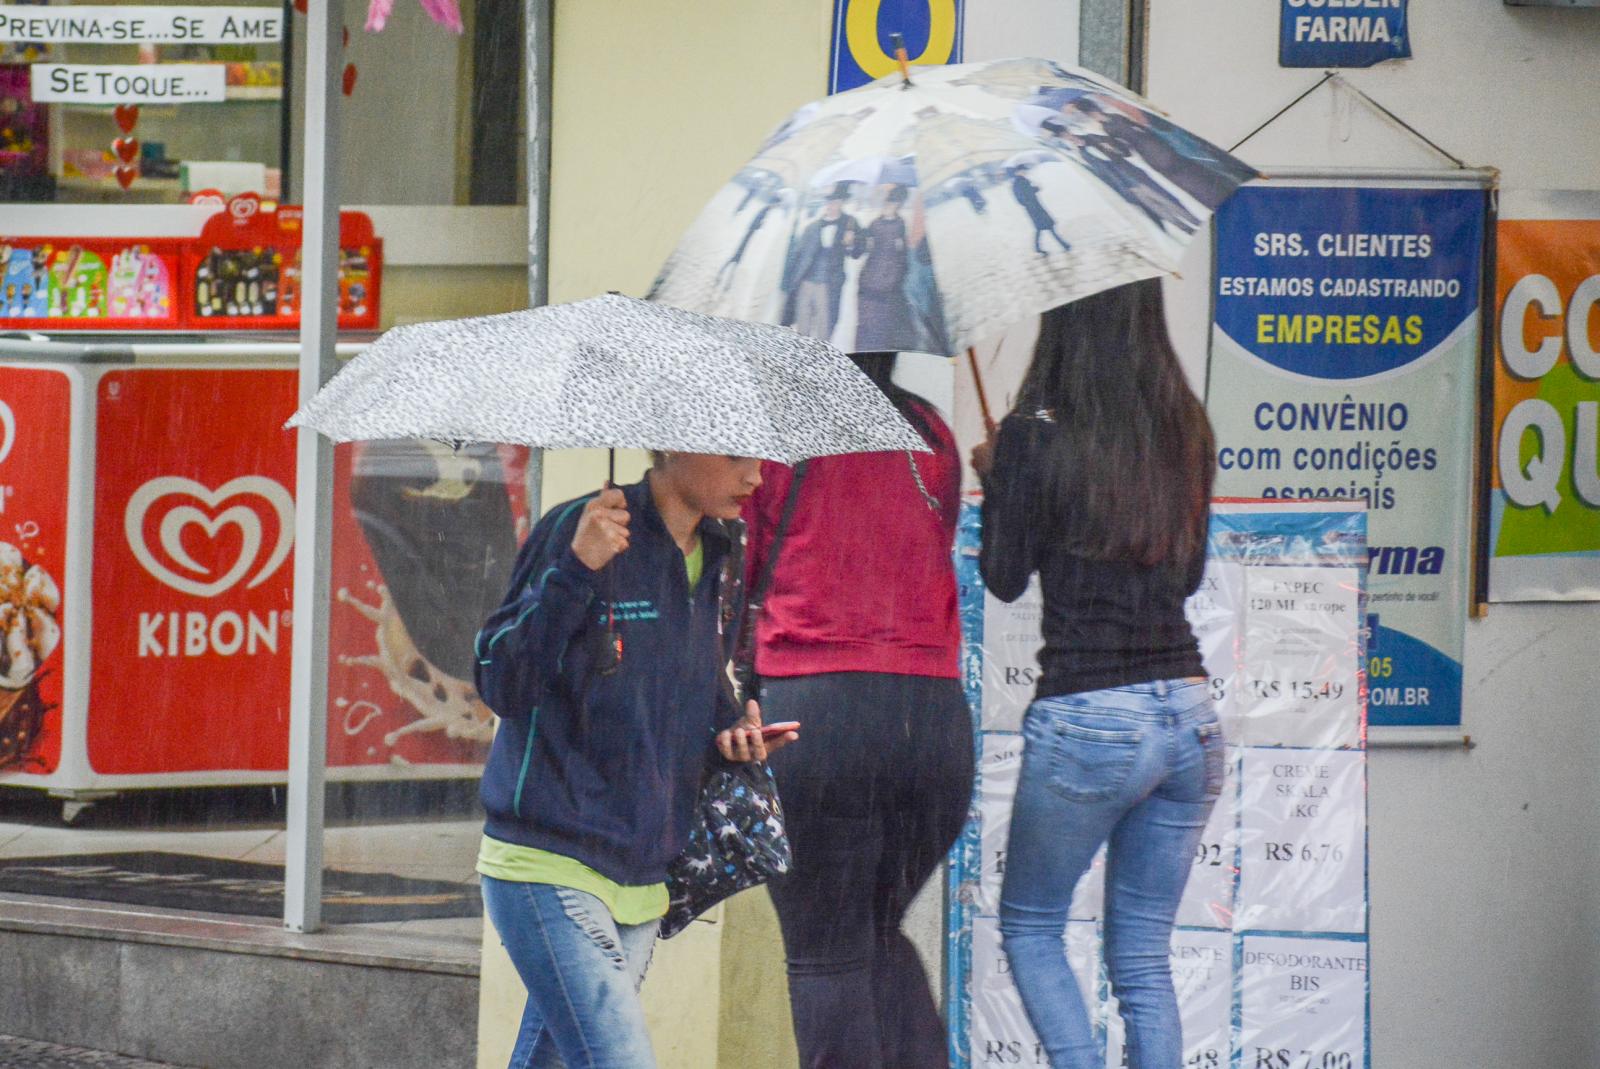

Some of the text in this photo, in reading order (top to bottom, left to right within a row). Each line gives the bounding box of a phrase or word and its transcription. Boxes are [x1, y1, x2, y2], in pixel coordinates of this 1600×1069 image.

[221, 16, 277, 38] AME
[1295, 16, 1391, 42] FARMA
[50, 68, 208, 96] SE TOQUE...
[1254, 233, 1432, 258] SRS. CLIENTES
[1219, 277, 1460, 298] ESTAMOS CADASTRANDO
[1256, 314, 1423, 345] EMPRESAS
[1254, 394, 1408, 432] CONVÊNIO
[1218, 441, 1438, 479] com condições
[138, 611, 278, 657] KIBON
[1245, 951, 1366, 971] DESODORANTE
[1290, 975, 1320, 991] BIS
